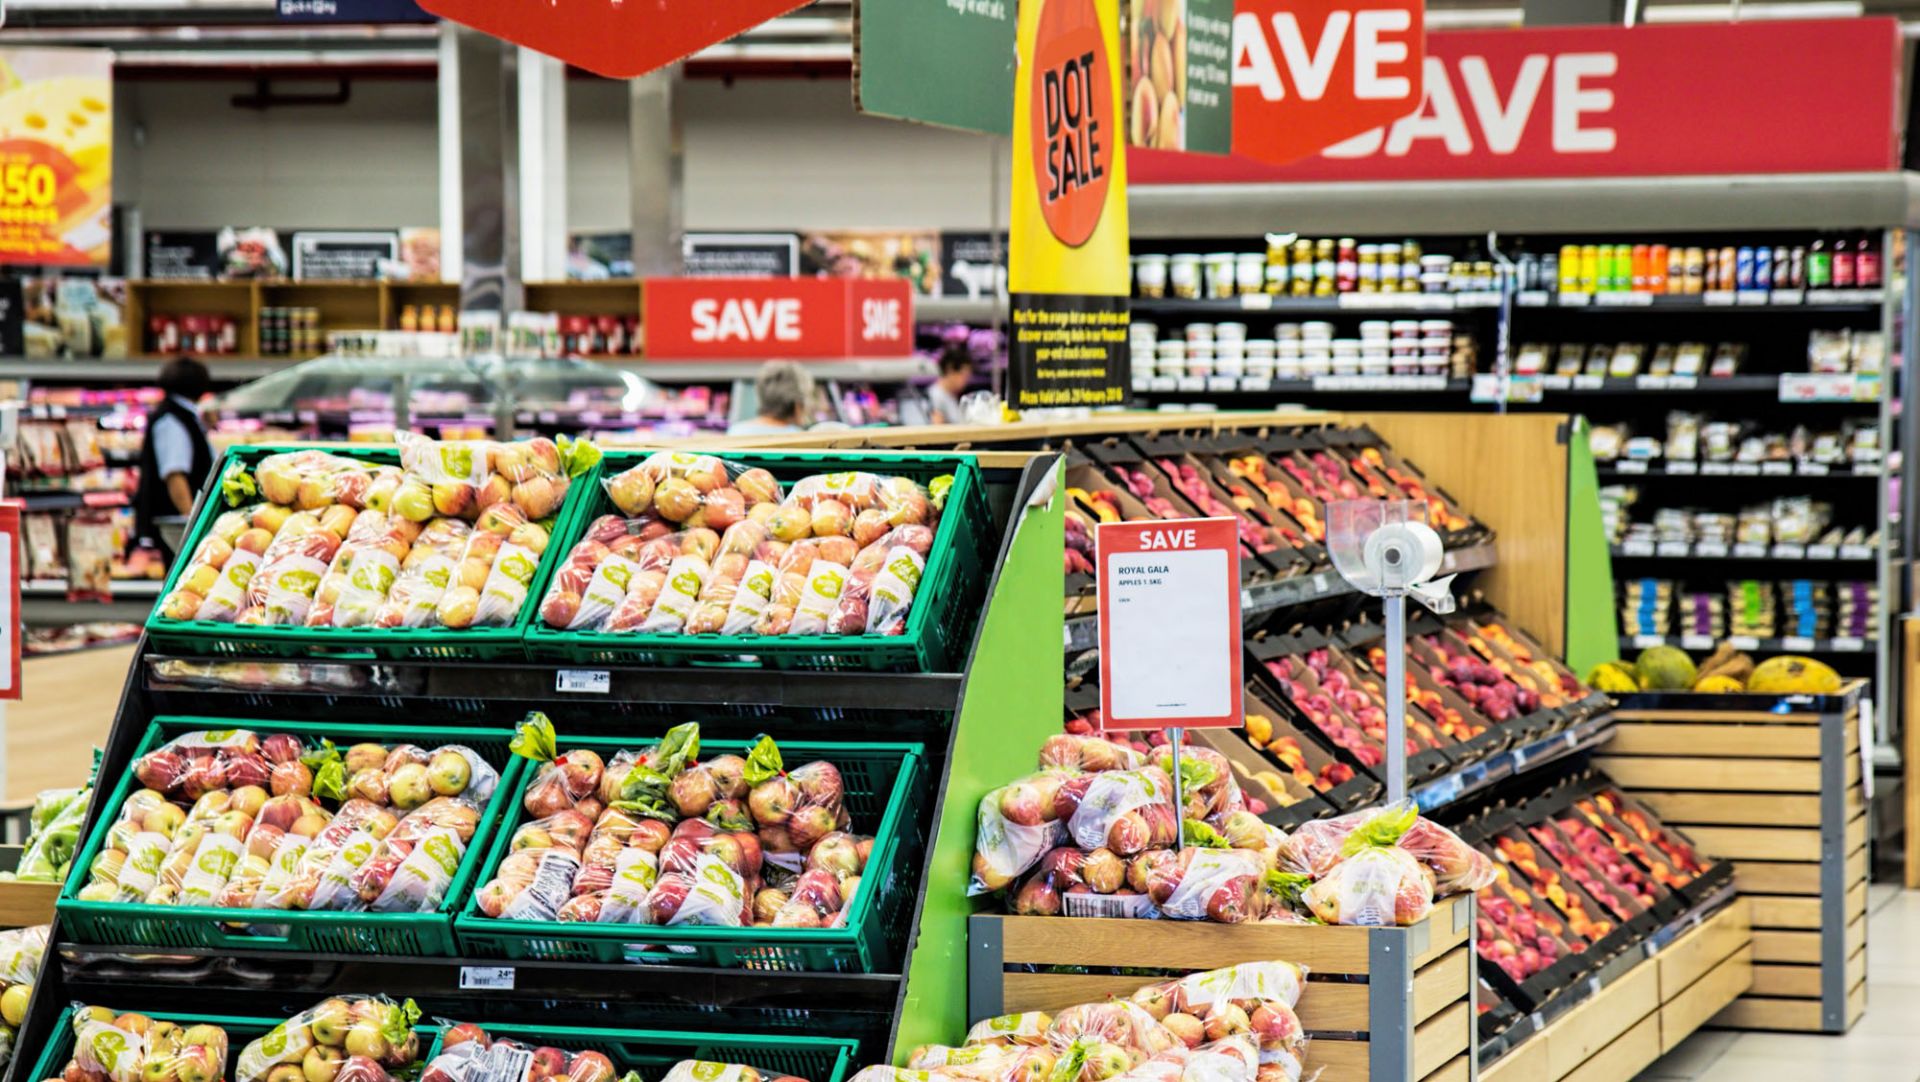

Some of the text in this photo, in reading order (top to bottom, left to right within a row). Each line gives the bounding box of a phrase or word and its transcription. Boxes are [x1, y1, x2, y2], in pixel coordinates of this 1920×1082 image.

[1043, 51, 1094, 141] DOT
[1321, 52, 1618, 158] AVE
[1047, 120, 1103, 203] SALE
[691, 298, 802, 341] SAVE
[862, 298, 901, 341] SAVE
[1139, 529, 1197, 550] SAVE
[1118, 565, 1170, 575] ROYAL GALA
